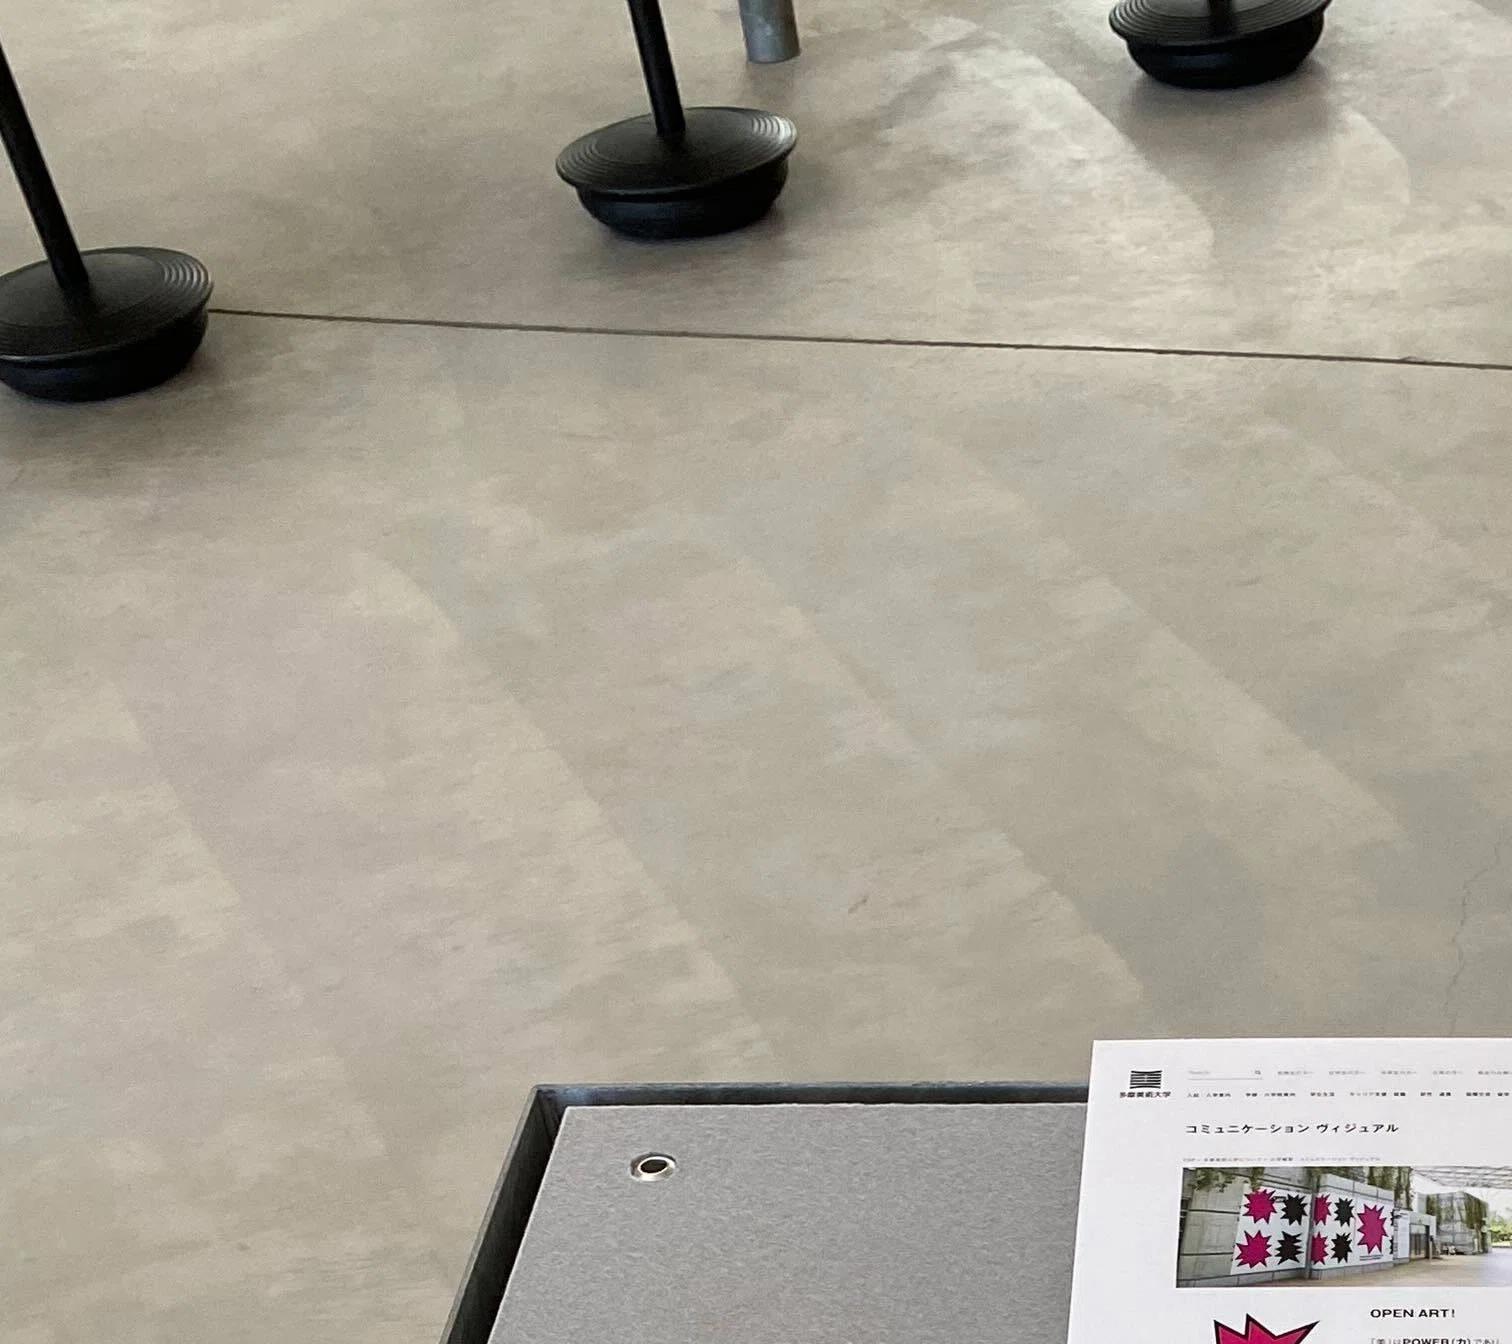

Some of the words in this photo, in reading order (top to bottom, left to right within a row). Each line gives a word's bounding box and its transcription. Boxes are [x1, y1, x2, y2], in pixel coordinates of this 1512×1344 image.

[1119, 1091, 1171, 1099] 多摩美術大学
[1185, 1123, 1309, 1135] コミュニケーション
[1316, 1122, 1399, 1134] ヴィジュアル
[1370, 1308, 1414, 1318] OPEN
